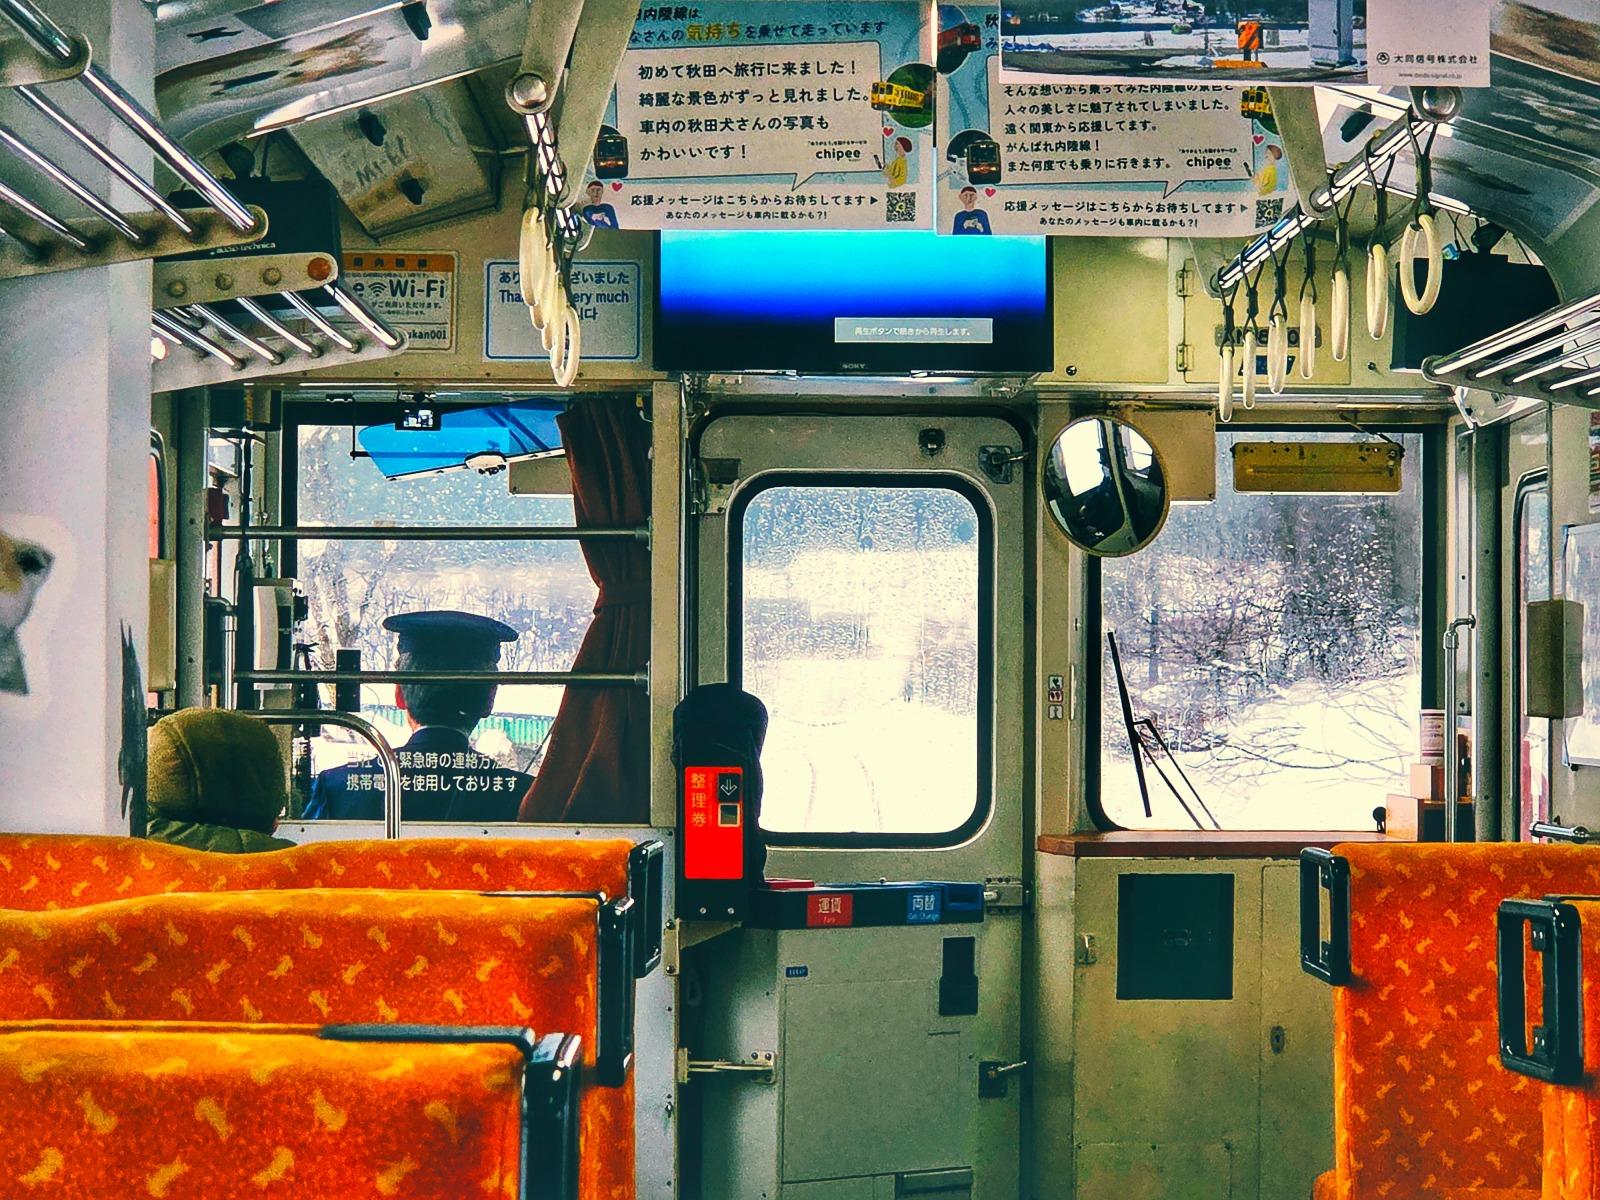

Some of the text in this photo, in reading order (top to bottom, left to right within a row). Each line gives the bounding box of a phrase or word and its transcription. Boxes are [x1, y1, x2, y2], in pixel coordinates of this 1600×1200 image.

[639, 87, 869, 107] 綺麗な景色がずっと見れました。
[1004, 99, 1229, 115] 人々の美しさに魅了されてしまいました。
[640, 115, 829, 134] 車内の秋田犬さんの写真も
[1005, 119, 1157, 134] 遠く関東から応援してます。
[640, 144, 746, 161] かわいいです！
[1006, 140, 1100, 153] がんばれ内陸線！
[815, 148, 861, 161] chipee
[1008, 157, 1170, 172] また何度でも乗りに行きます。
[1186, 156, 1231, 169] chipee
[631, 194, 866, 206] 応援メッセージはこちらからお待ちしてます
[1004, 200, 1236, 213] 応援メッセージはこちらからお待ちしてます
[389, 279, 444, 298] Wi-Fi
[596, 290, 629, 303] much
[346, 774, 518, 792] 携帯電を使用しております
[691, 772, 707, 828] 整理券
[912, 894, 935, 911] 両替
